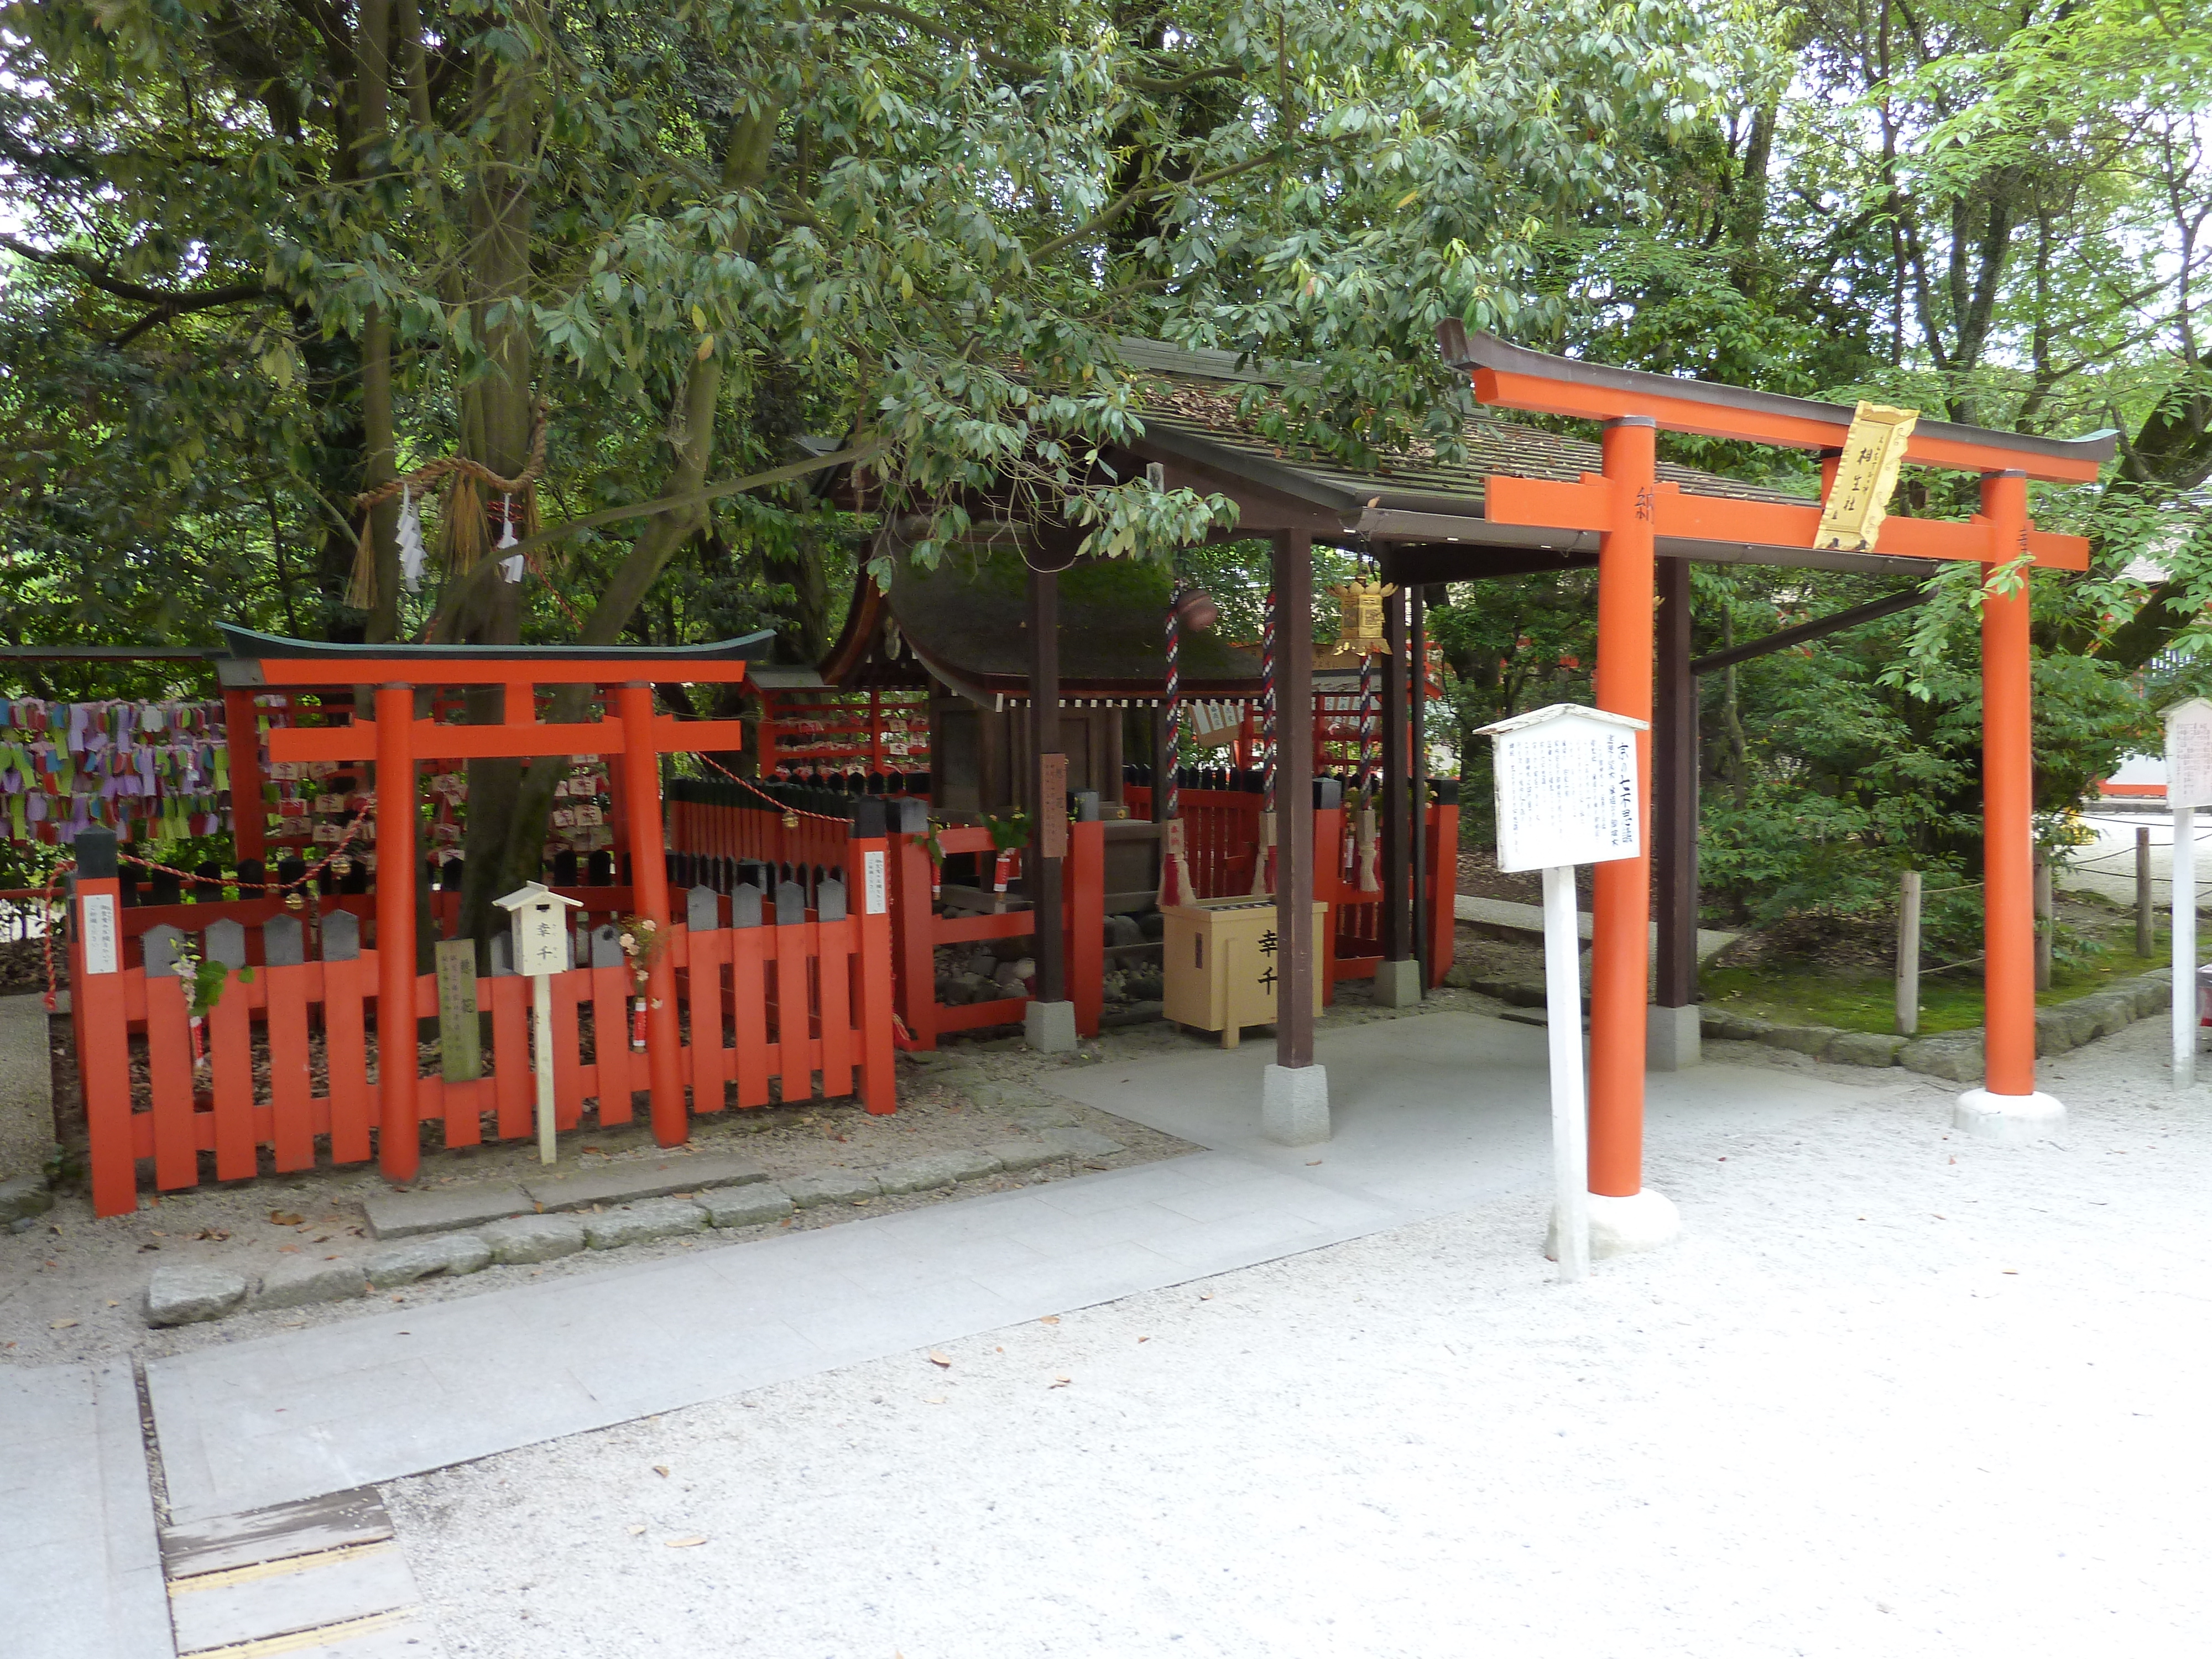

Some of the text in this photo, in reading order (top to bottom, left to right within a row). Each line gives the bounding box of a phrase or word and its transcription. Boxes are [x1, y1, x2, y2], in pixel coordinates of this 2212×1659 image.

[1843, 447, 1872, 511] 相生社
[1617, 742, 1633, 843] 京の七不思議
[536, 922, 552, 960] 幸千
